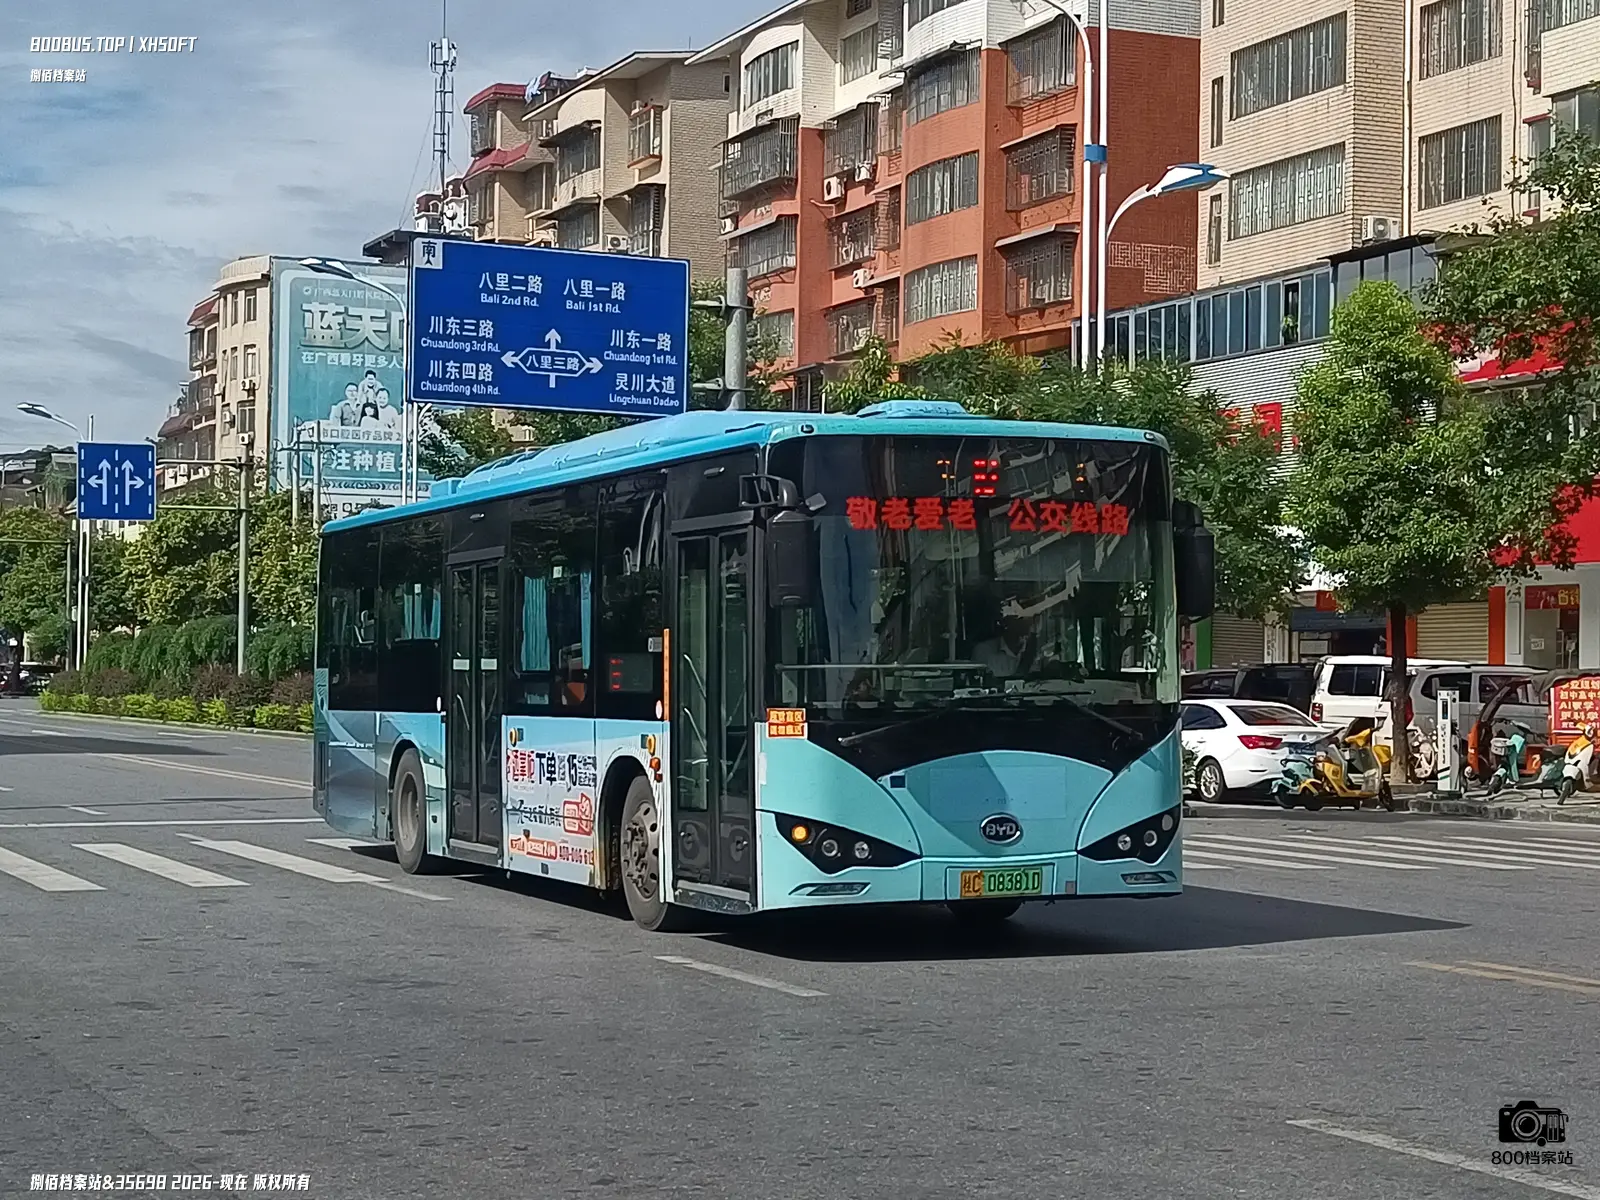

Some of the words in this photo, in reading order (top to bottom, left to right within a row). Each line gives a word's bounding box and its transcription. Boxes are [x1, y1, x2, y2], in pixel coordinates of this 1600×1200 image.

[421, 240, 437, 258] 南
[479, 272, 543, 294] 八里二路
[563, 279, 626, 301] 八里一路
[480, 293, 500, 305] Bali
[501, 295, 521, 306] 2nd
[523, 296, 540, 307] Rd.
[566, 300, 585, 310] Bali
[588, 302, 603, 312] 1st
[605, 303, 622, 313] Rd.
[429, 316, 494, 339] 川东三路
[420, 337, 470, 352] Chuandong
[471, 340, 487, 352] 3rd
[487, 342, 501, 352] Rd.
[610, 329, 672, 351] 川东一路
[301, 351, 404, 369] 在广西看牙更多人
[526, 354, 580, 371] 八里三路
[603, 351, 650, 365] Chuandong
[652, 354, 664, 364] 1st
[665, 355, 678, 365] Rd.
[428, 360, 493, 382] 川东四路
[420, 381, 470, 395] Chuandong
[471, 383, 487, 395] 4th
[487, 385, 501, 395] Rd.
[615, 373, 676, 394] 灵川大道
[609, 393, 651, 406] Lingchuan
[653, 396, 680, 407] Dadao
[846, 497, 976, 530] 敬老爱老
[1007, 498, 1129, 536] 公交线路
[985, 823, 1016, 836] BYD
